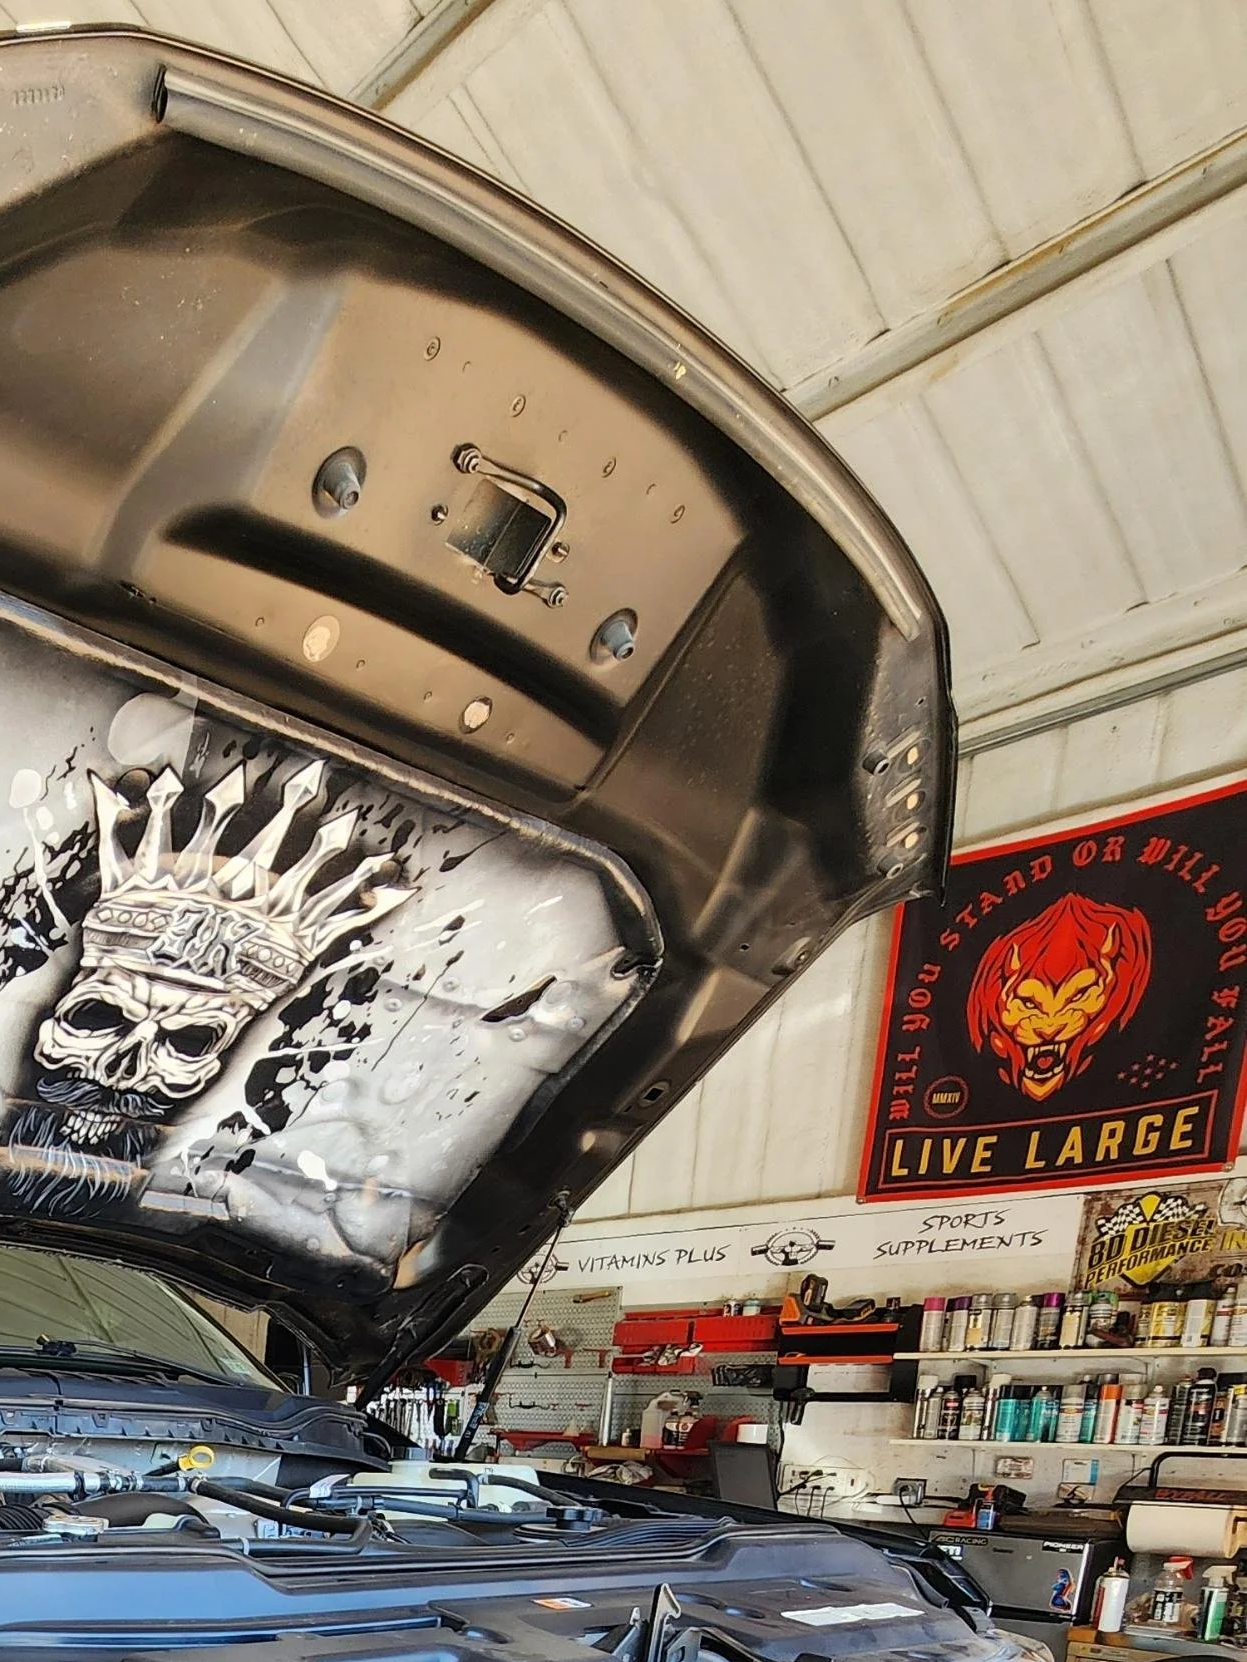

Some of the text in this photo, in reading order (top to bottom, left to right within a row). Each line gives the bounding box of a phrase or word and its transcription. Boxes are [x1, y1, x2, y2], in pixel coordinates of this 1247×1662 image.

[888, 835, 1247, 1121] WILL YOU STAND OR WILL YOU FALL
[931, 1091, 961, 1105] MMXIV
[890, 1106, 1200, 1178] LIVE LARGE
[917, 1208, 1011, 1234] SPORTS
[577, 1243, 733, 1273] VITAMINS PLUS
[872, 1229, 1050, 1260] SUPPLEMENTS
[1088, 1218, 1216, 1271] BD DIESEL
[1084, 1238, 1214, 1290] PERFORMANCE
[955, 1537, 988, 1545] RACING
[1043, 1541, 1084, 1550] PIONEER
